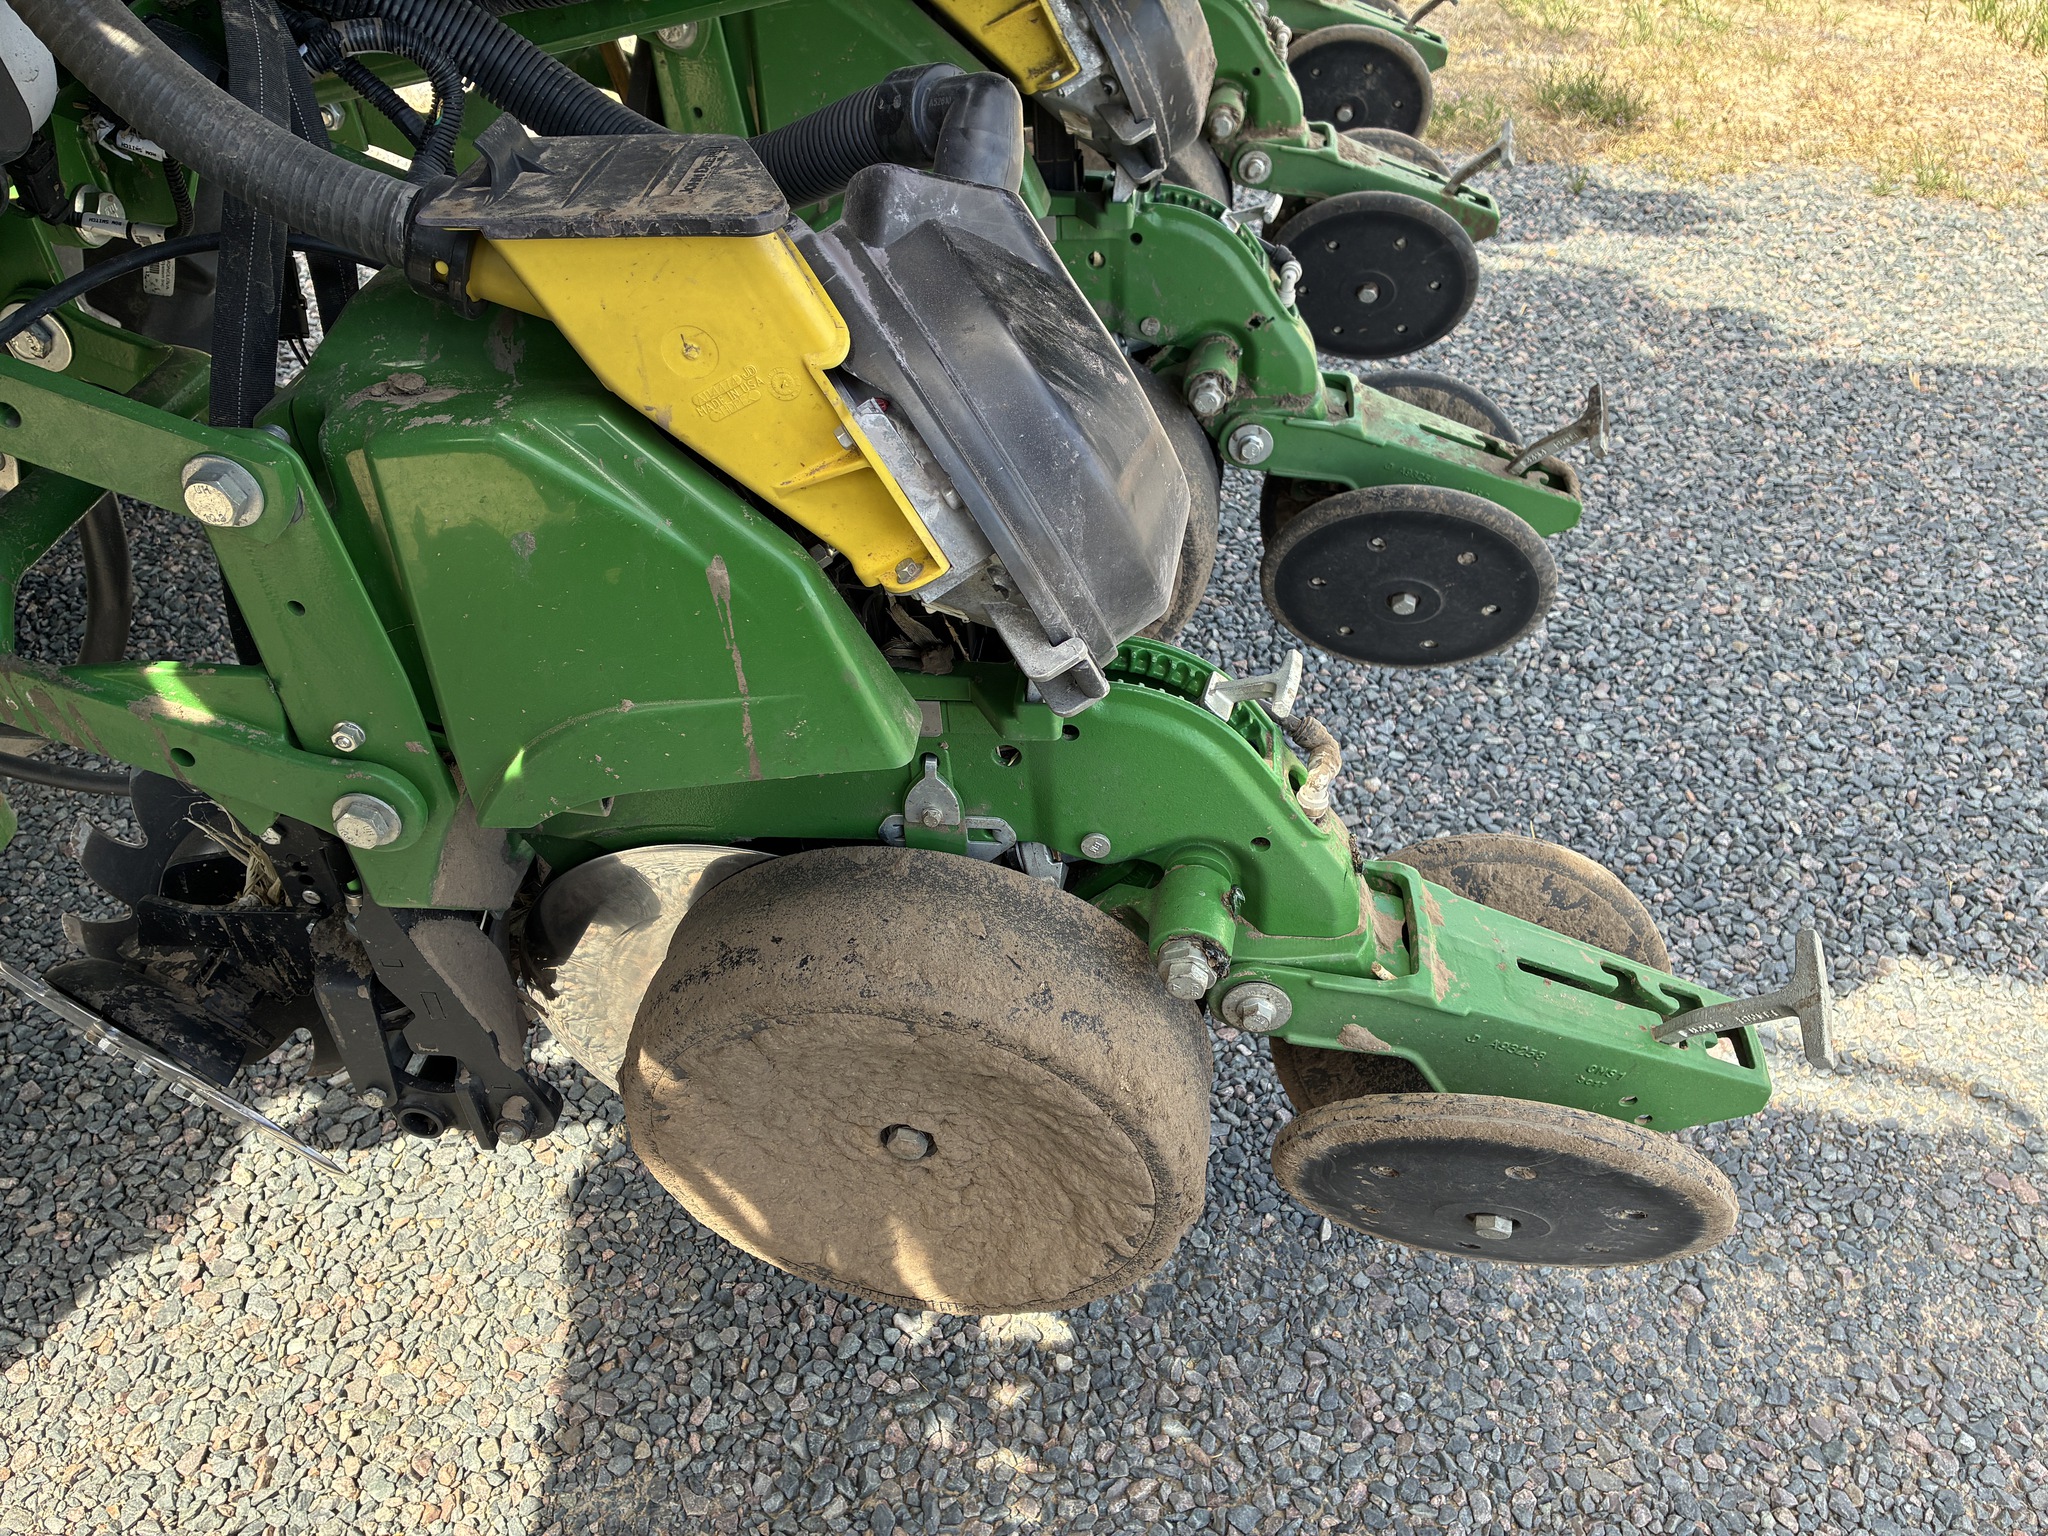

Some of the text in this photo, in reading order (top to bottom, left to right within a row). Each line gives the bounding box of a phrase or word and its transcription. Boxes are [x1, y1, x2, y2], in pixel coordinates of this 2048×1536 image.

[696, 395, 725, 417] MADE
[727, 388, 740, 402] IN
[741, 376, 765, 394] USA
